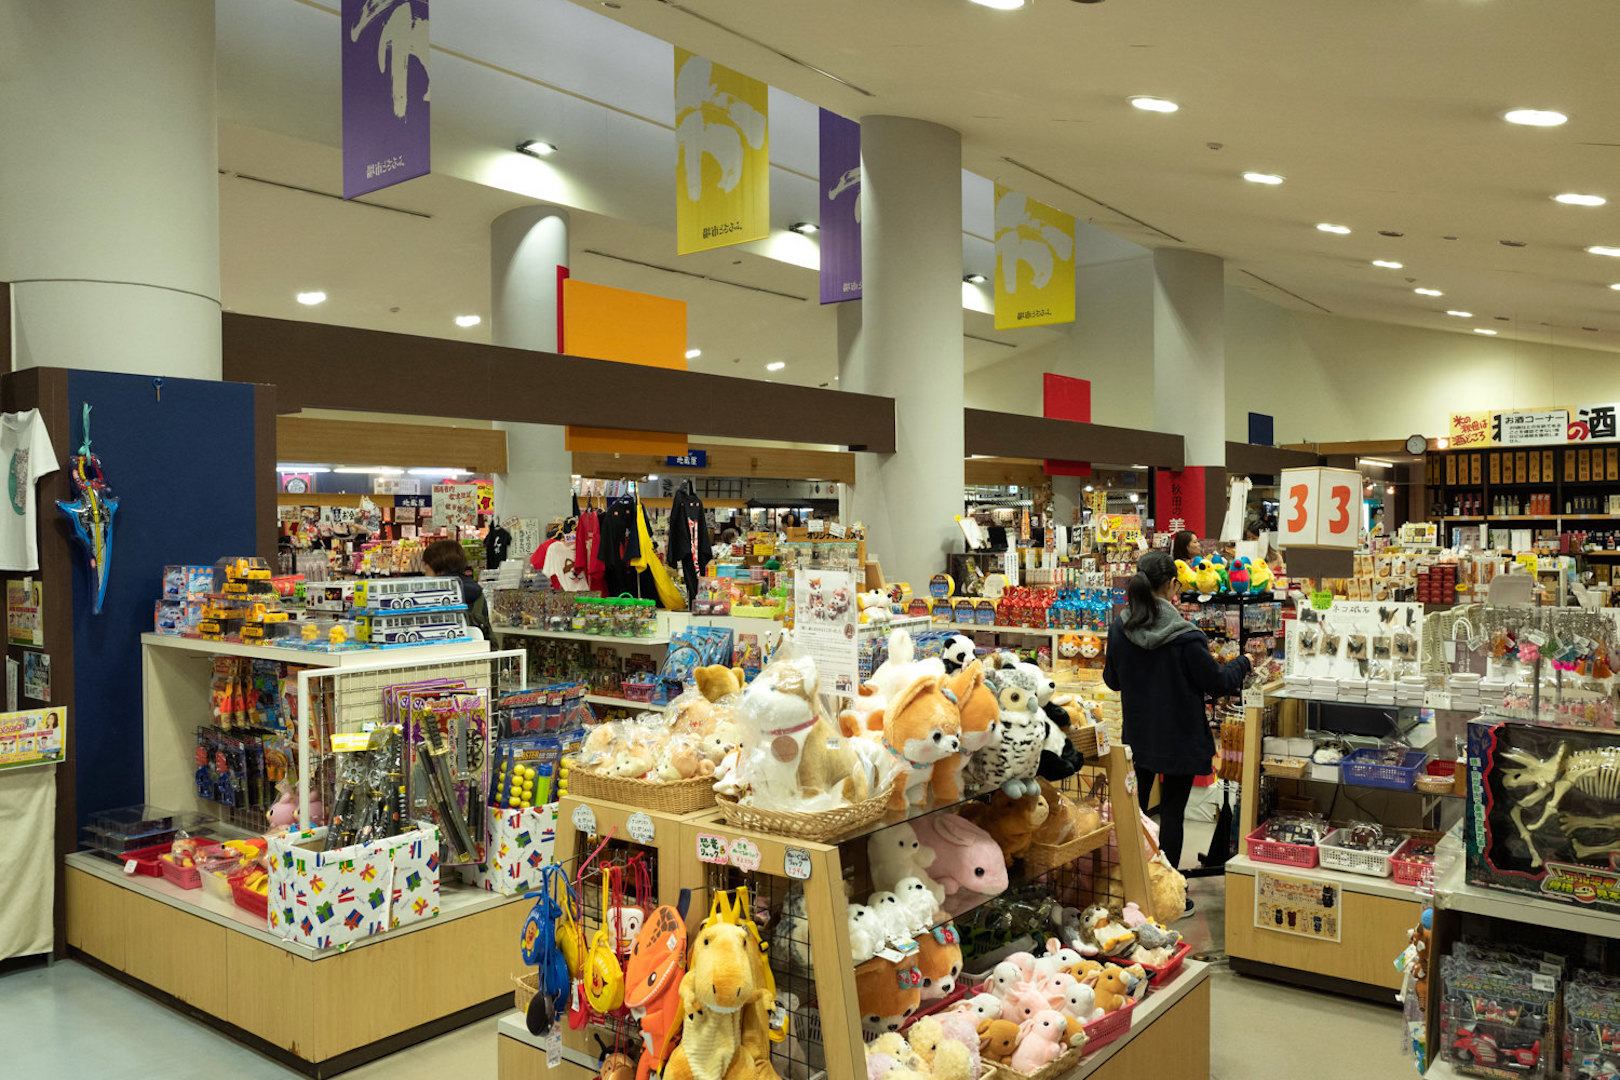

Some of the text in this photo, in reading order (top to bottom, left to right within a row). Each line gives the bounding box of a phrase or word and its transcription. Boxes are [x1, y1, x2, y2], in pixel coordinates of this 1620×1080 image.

[1505, 414, 1565, 424] お酒コーナー
[1287, 484, 1308, 533] 3
[1328, 485, 1351, 534] 3
[700, 838, 719, 850] 恐竜
